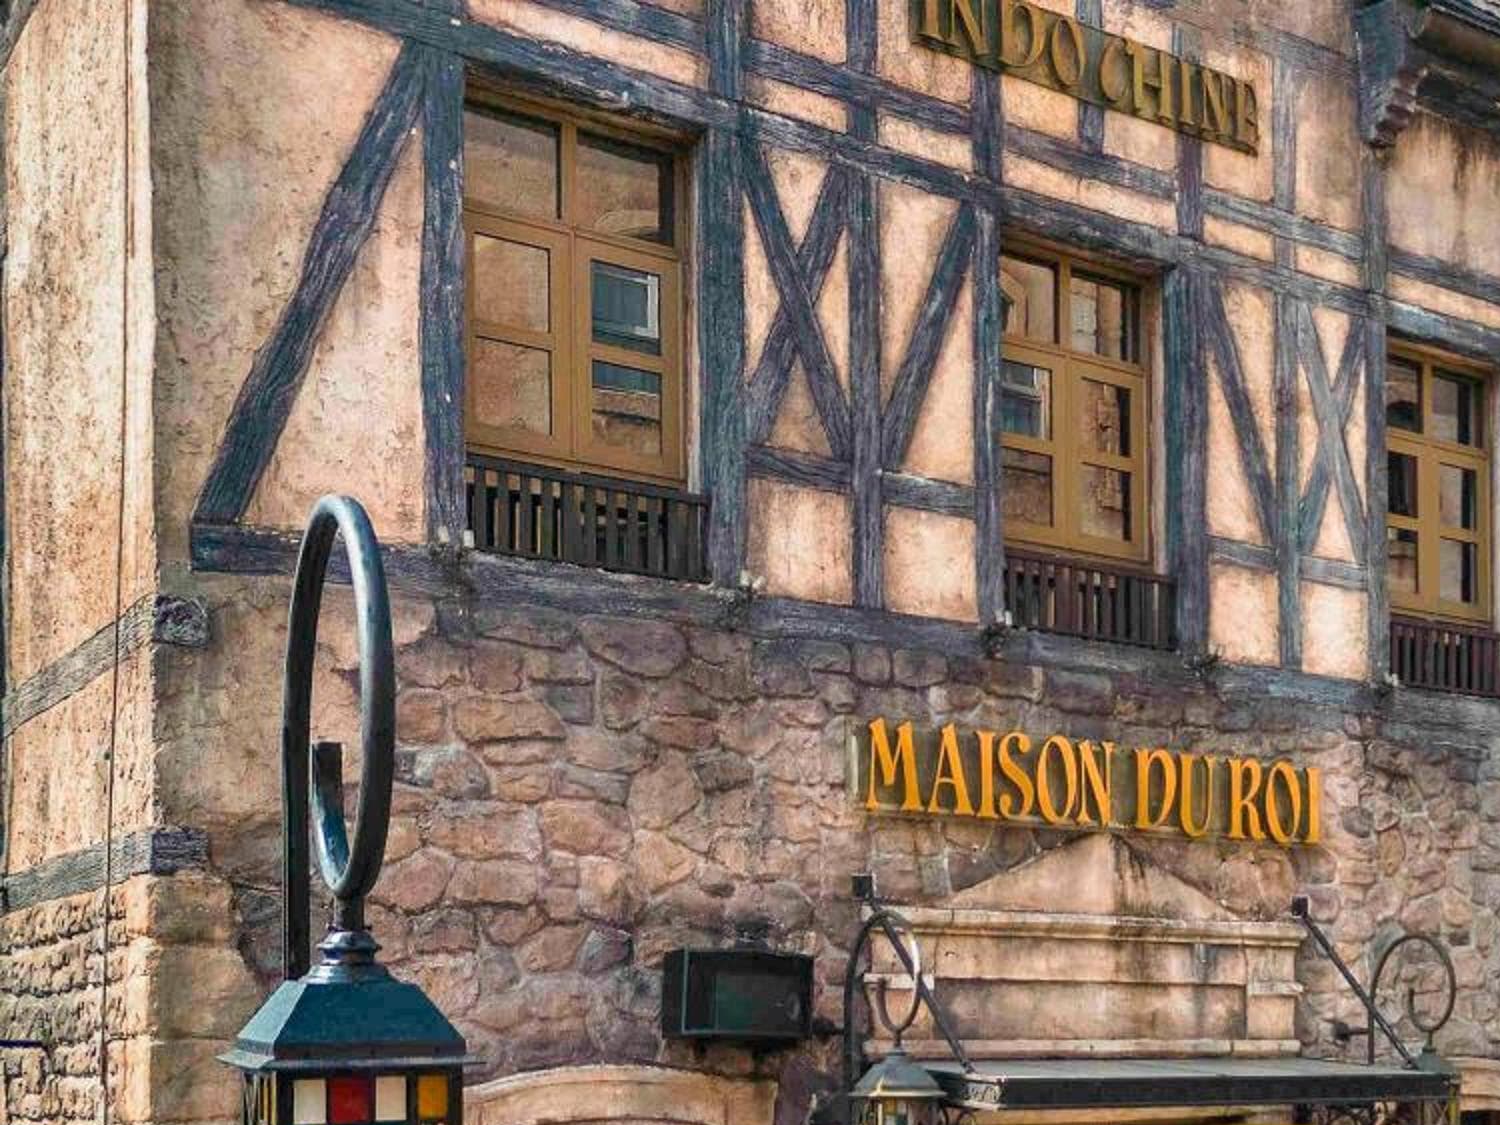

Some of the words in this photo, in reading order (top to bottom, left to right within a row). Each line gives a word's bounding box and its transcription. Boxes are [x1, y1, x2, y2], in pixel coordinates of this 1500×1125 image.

[865, 717, 1115, 828] MAISON
[1134, 748, 1216, 838] DU
[1226, 756, 1323, 846] ROI
